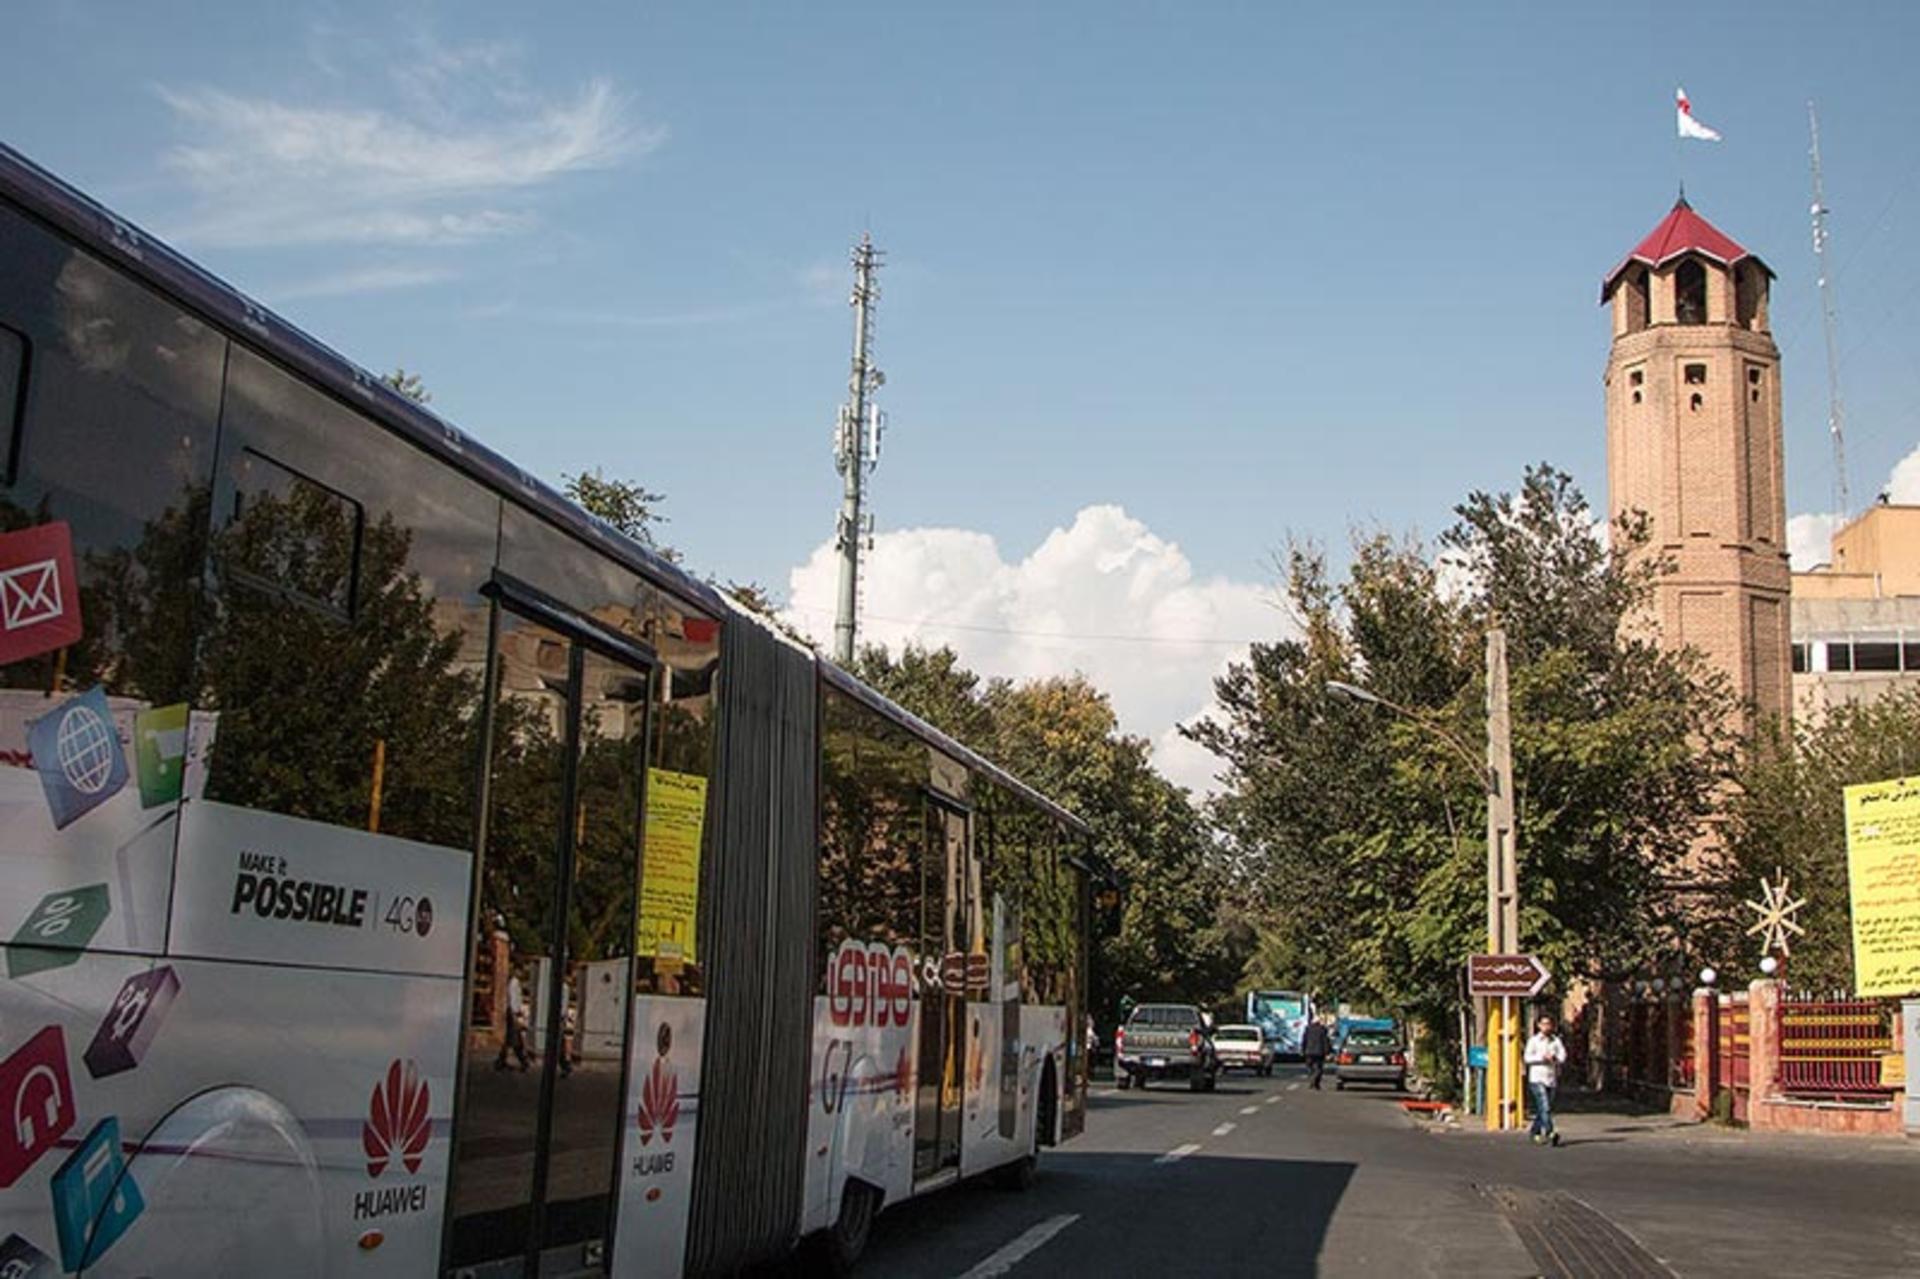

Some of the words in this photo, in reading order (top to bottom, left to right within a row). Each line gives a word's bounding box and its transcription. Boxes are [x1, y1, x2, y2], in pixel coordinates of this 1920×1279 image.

[239, 852, 275, 874] MAKE
[231, 874, 368, 927] POSSIBLE
[1133, 1035, 1179, 1047] TOYOTA
[354, 1184, 427, 1220] HUAWEI
